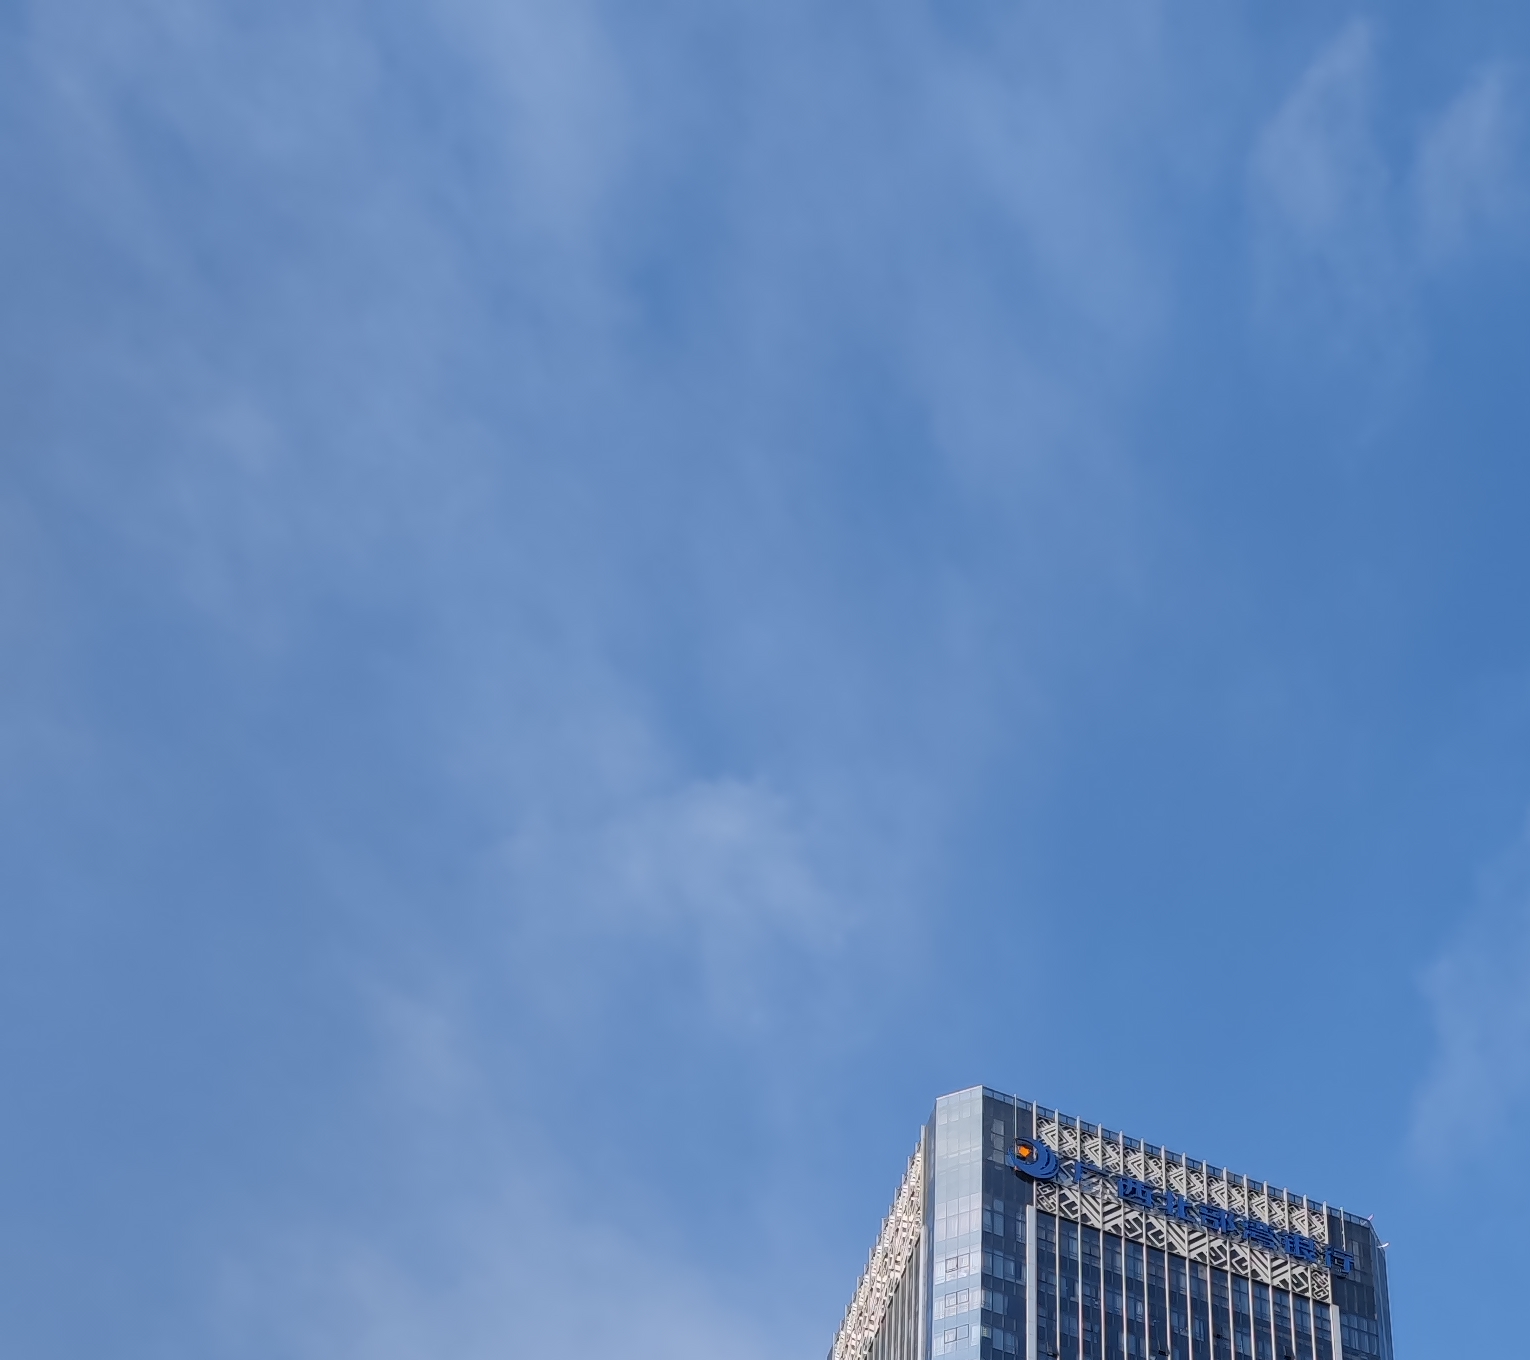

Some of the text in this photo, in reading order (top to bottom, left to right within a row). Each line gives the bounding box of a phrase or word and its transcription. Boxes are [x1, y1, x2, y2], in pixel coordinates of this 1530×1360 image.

[1072, 1162, 1356, 1276] 广西北部湾银行
